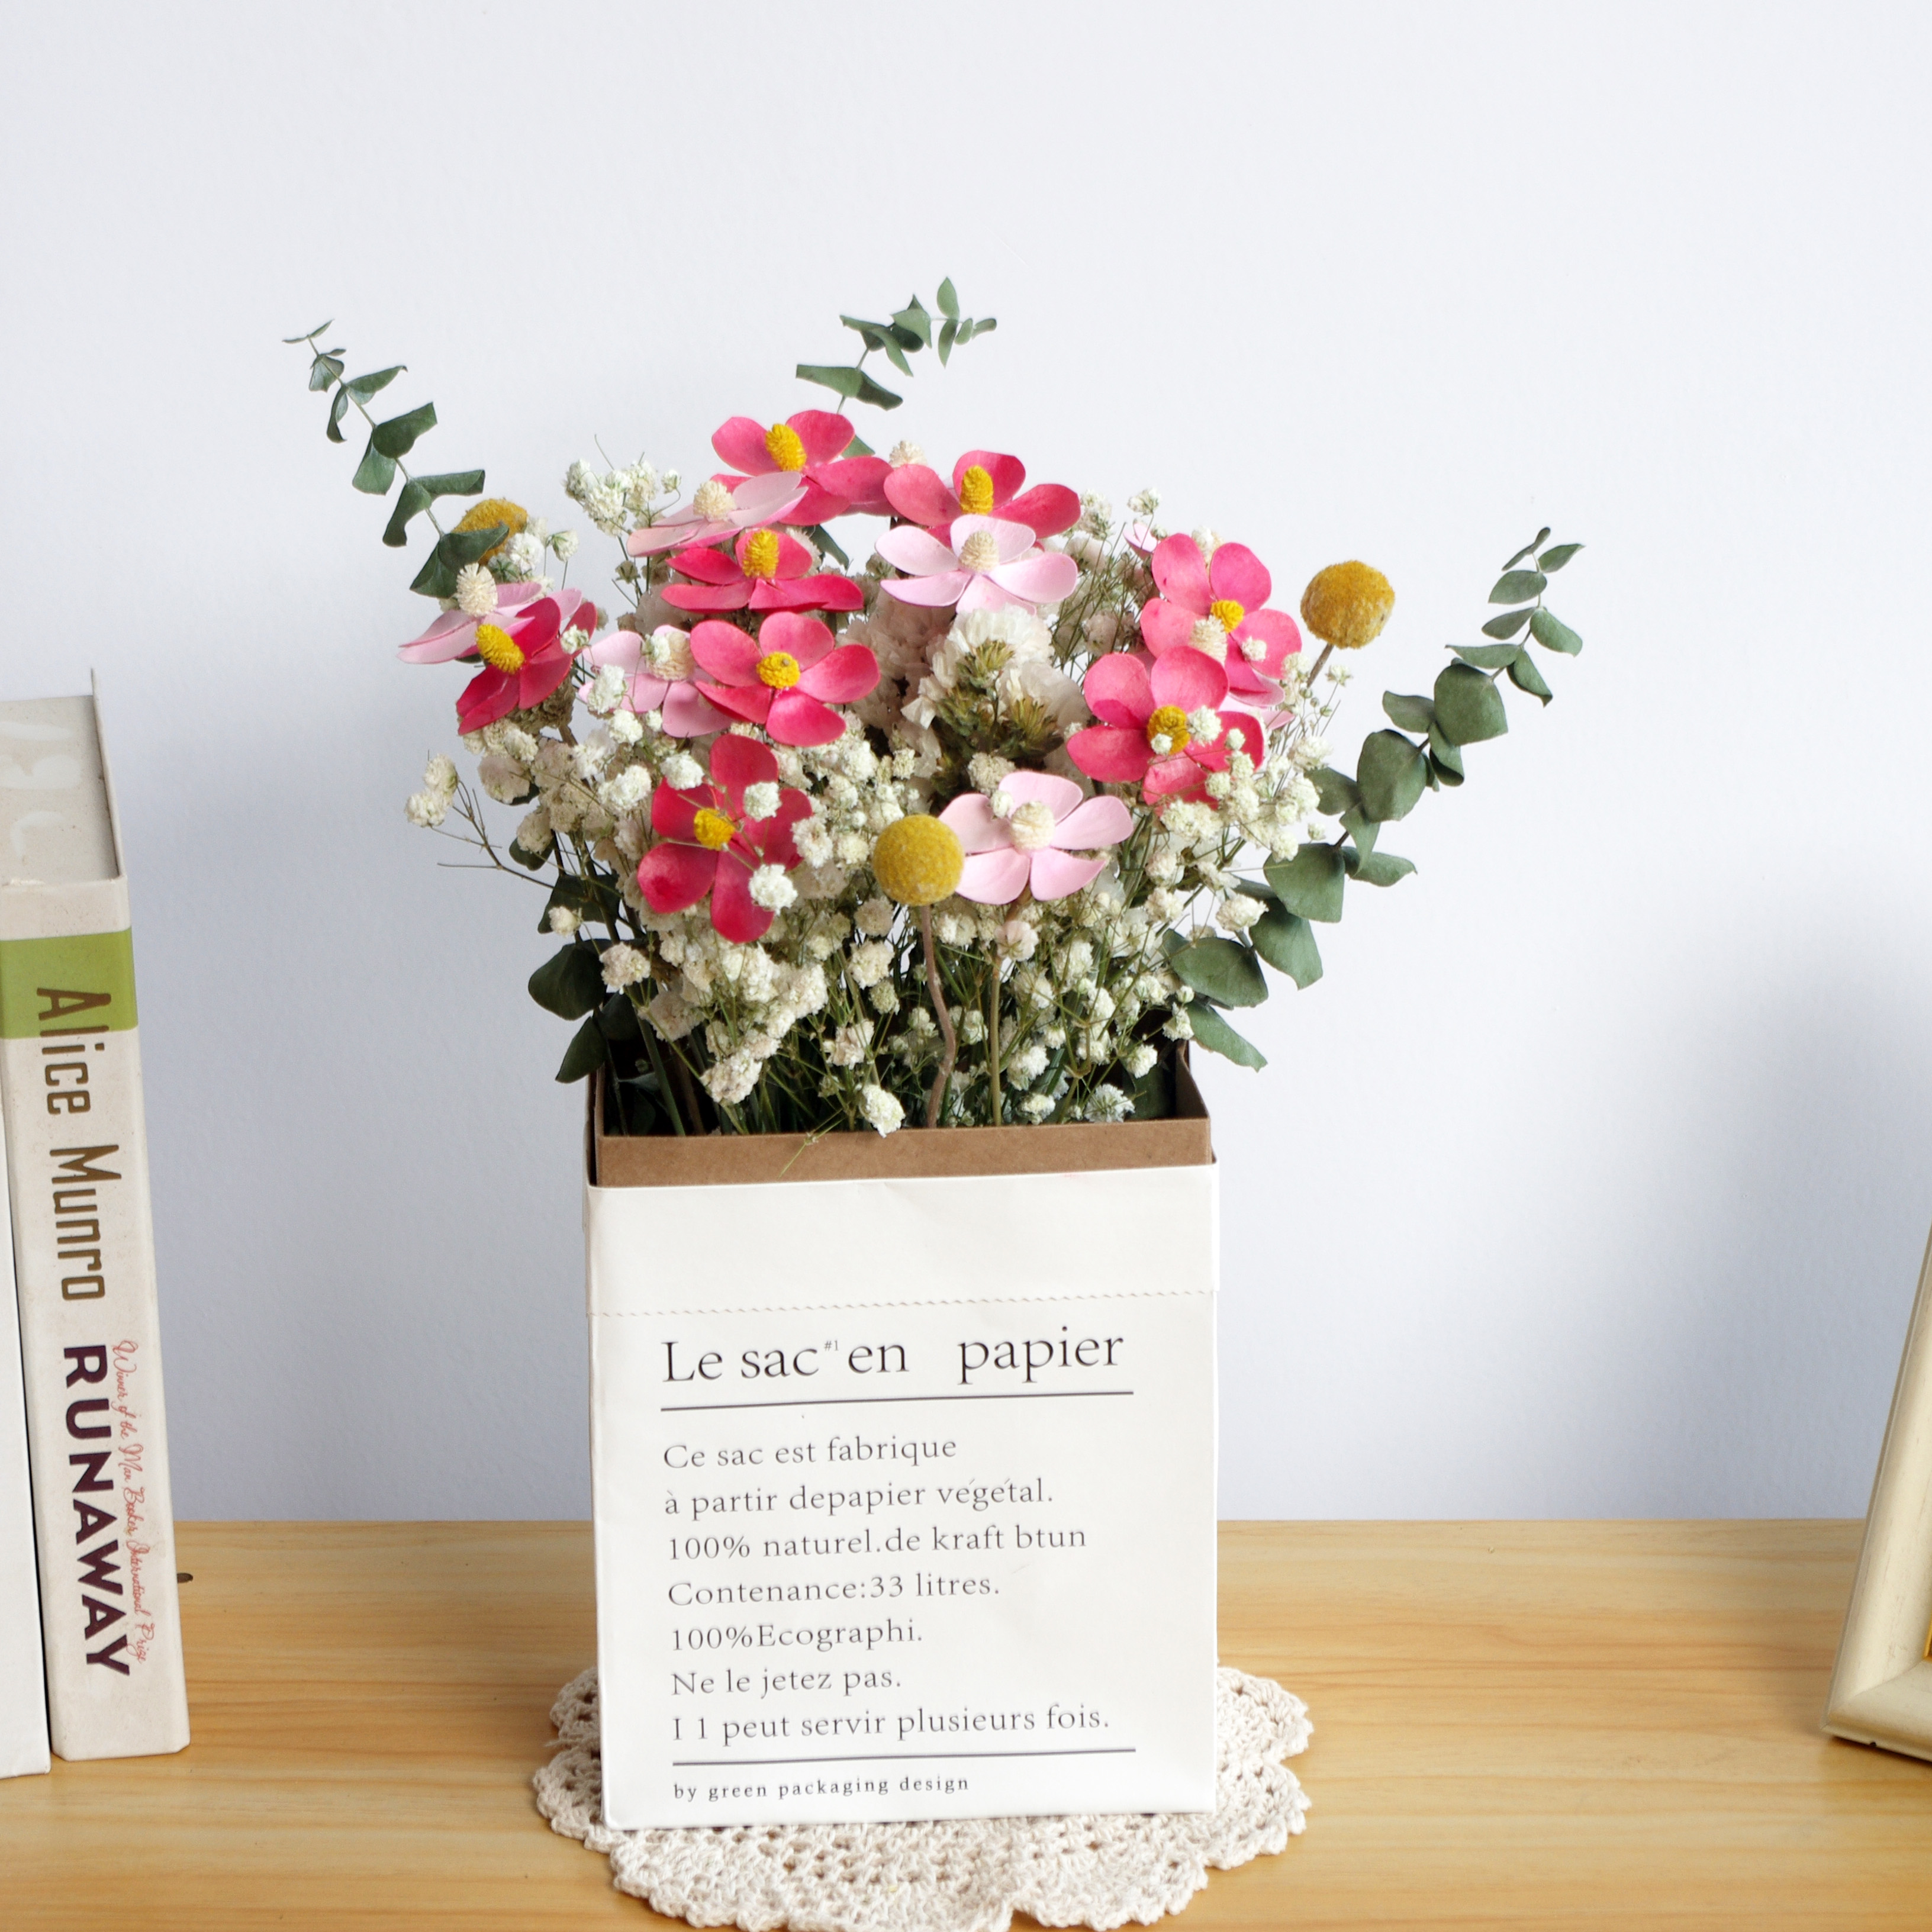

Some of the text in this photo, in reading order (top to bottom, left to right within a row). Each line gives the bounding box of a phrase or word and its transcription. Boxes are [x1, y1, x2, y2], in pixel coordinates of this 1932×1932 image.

[36, 987, 122, 1300] Alice Munro
[660, 1340, 724, 1383] Le
[740, 1347, 820, 1380] sac
[847, 1343, 910, 1375] en
[956, 1325, 1125, 1386] papier
[663, 1434, 957, 1469] Ce sac est fabrique
[63, 1344, 130, 1676] RUNAWAY
[111, 1340, 155, 1664] Winner of the Man Booker International Prize
[664, 1476, 1053, 1522] à partir depapier végétal.
[669, 1535, 751, 1561] 100%
[931, 1523, 1005, 1551] kraft
[1014, 1523, 1087, 1550] btun
[667, 1572, 1000, 1606] Contenance:33 litres.
[670, 1667, 901, 1700] Ne le jetez pas.
[722, 1715, 790, 1748] peut
[800, 1709, 887, 1737] servir
[897, 1706, 1036, 1742] plusieurs
[1046, 1702, 1109, 1730] fois.
[672, 1775, 969, 1803] by green packaging design
